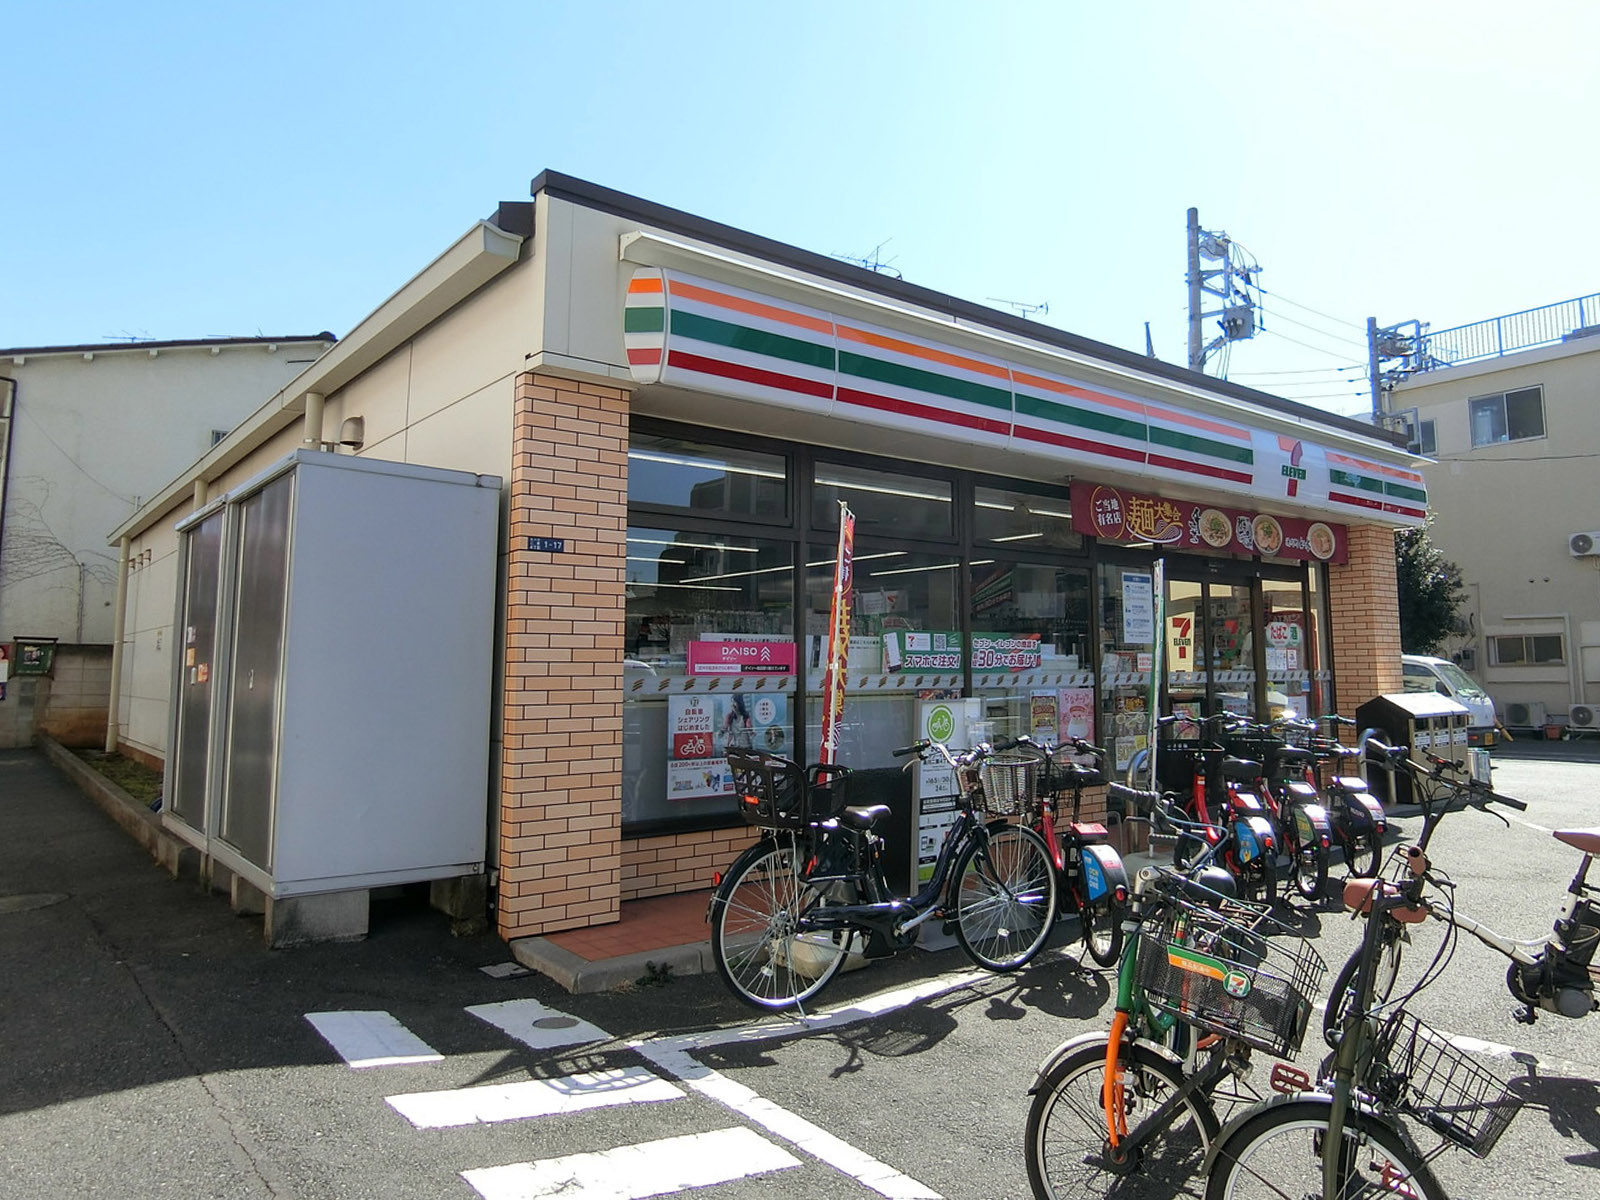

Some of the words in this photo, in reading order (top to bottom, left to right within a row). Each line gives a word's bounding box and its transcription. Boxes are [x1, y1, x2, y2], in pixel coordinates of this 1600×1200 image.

[1095, 498, 1119, 512] ご当地
[1097, 512, 1122, 526] 有名店
[1126, 496, 1182, 540] 麺大集合
[543, 540, 562, 549] 1-17
[1172, 617, 1191, 659] 7
[1270, 625, 1289, 640] たばこ
[721, 646, 758, 656] DAISO
[677, 715, 710, 724] シェアリング
[677, 723, 710, 732] はじめました
